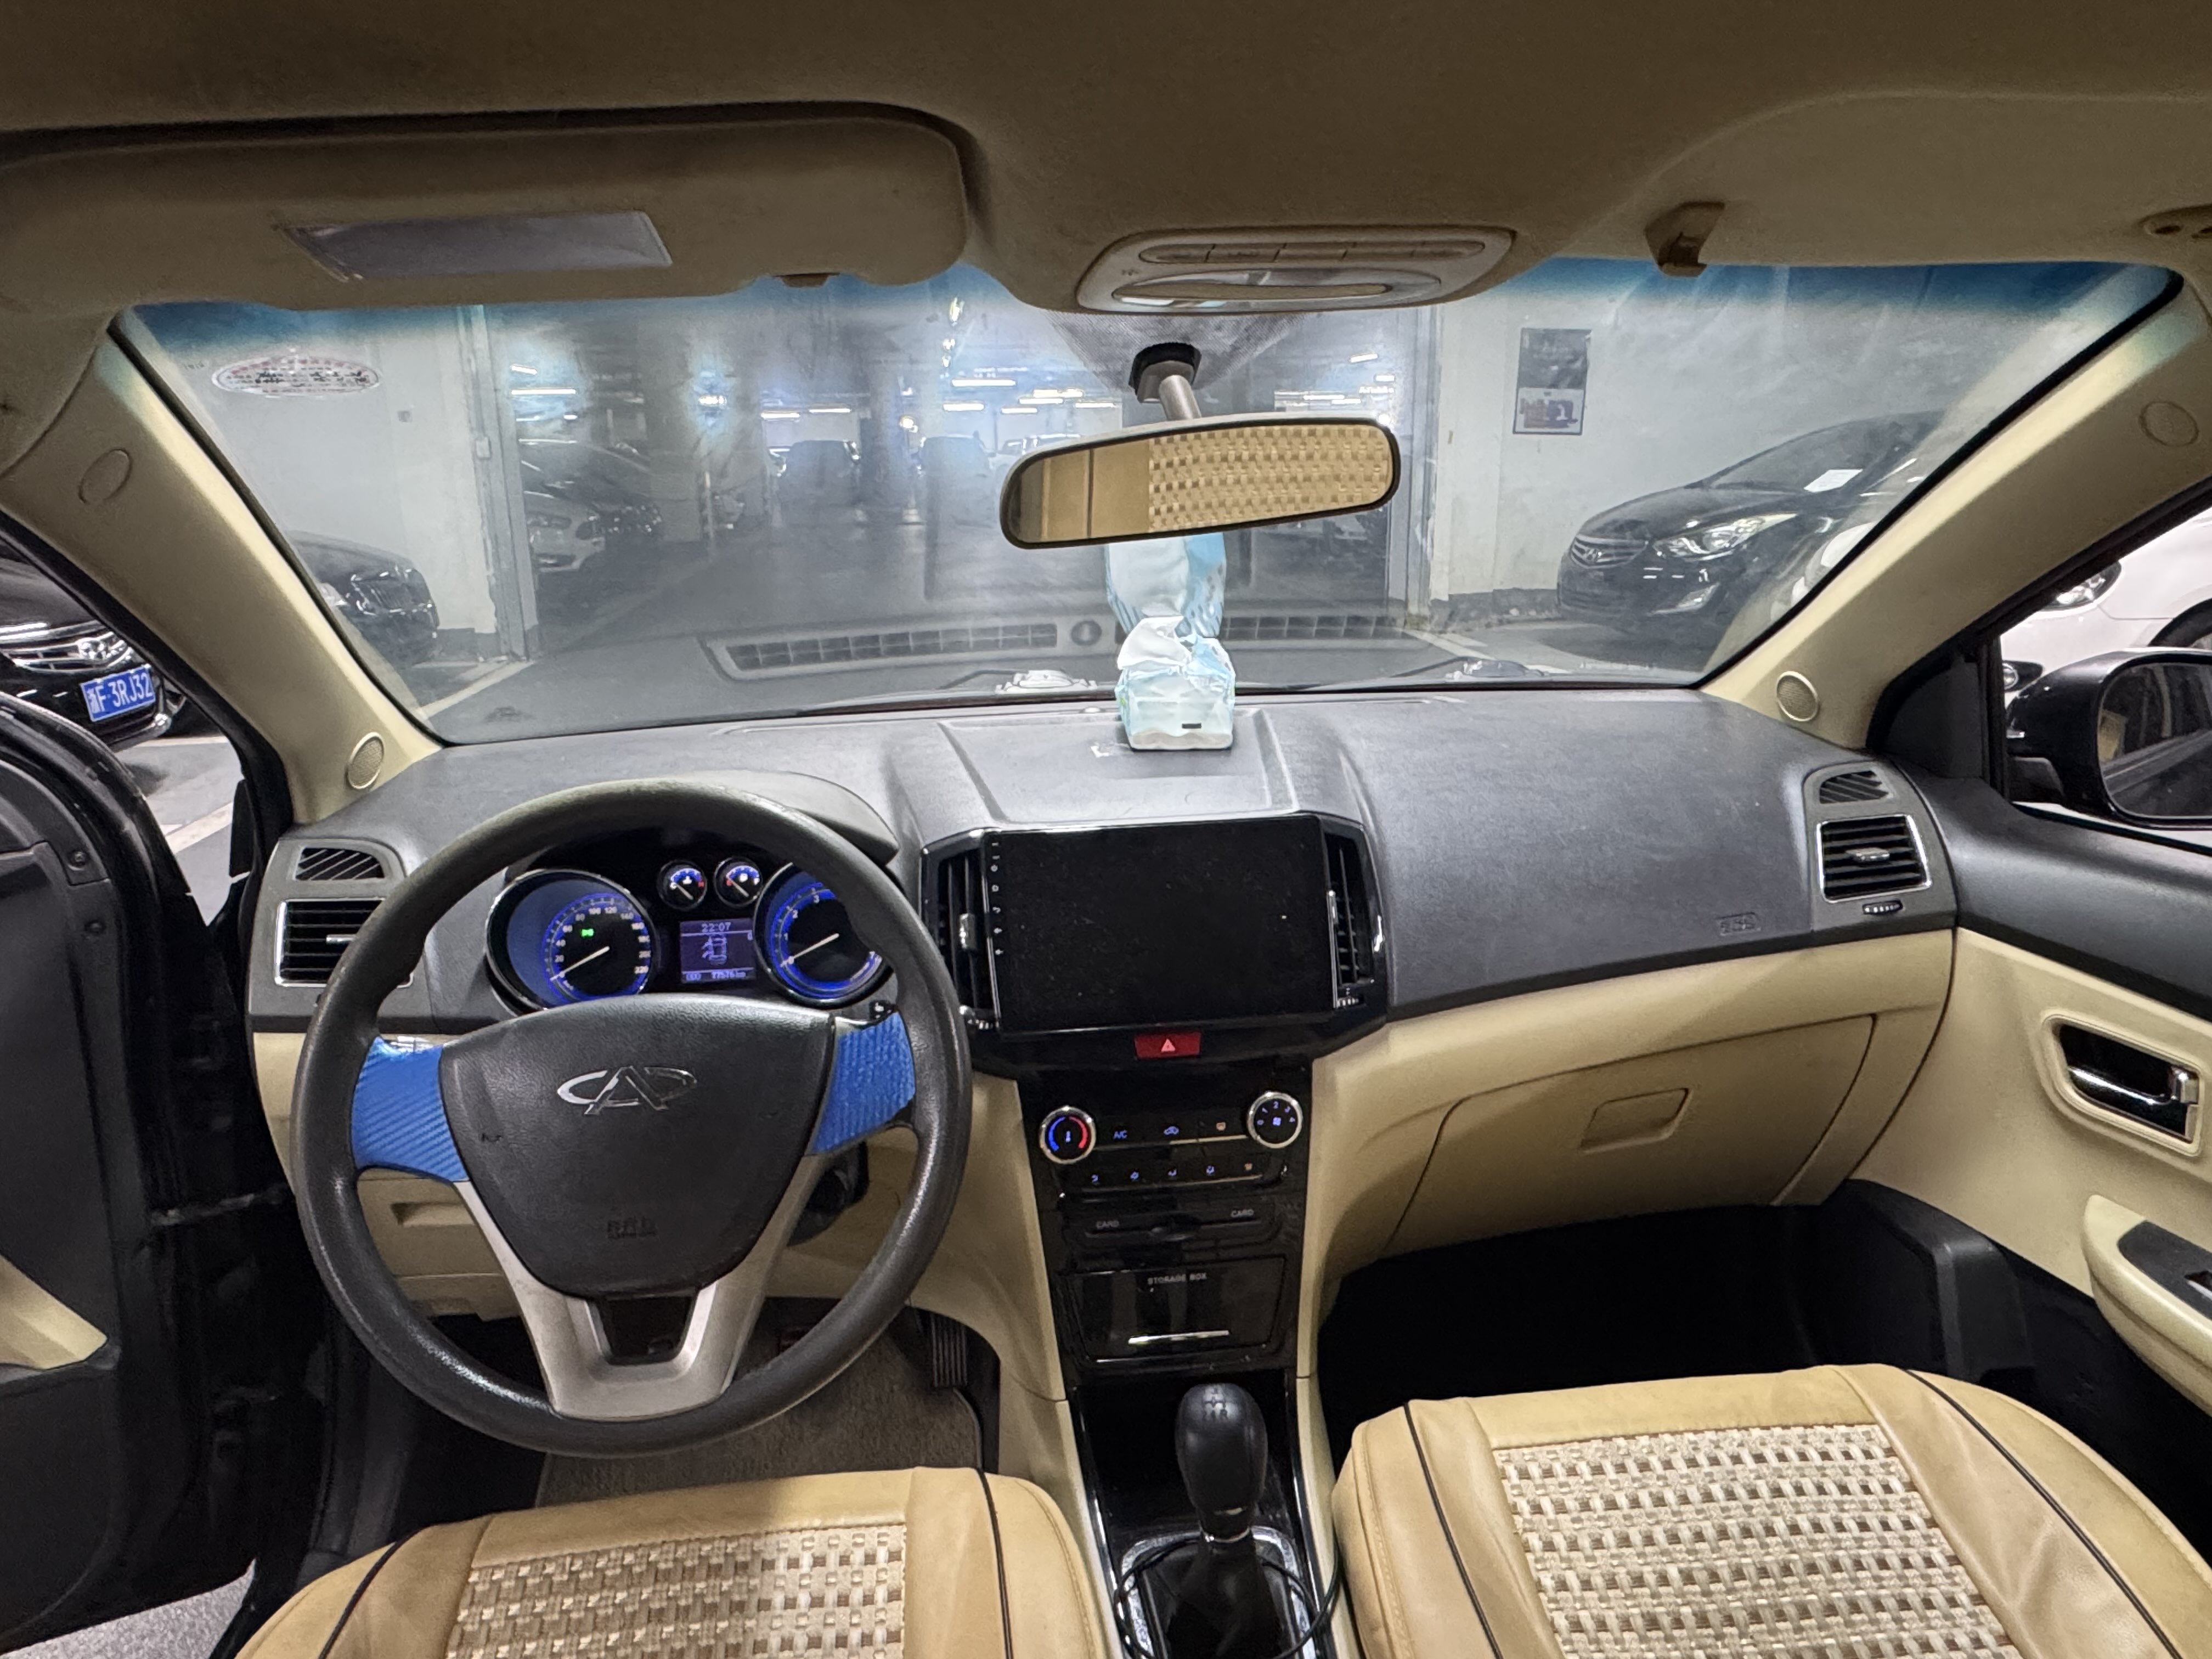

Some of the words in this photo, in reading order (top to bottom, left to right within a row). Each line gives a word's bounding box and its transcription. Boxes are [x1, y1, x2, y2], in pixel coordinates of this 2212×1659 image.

[813, 894, 820, 904] 3
[792, 910, 799, 919] 2
[563, 924, 573, 933] 60
[701, 922, 731, 933] 22:07
[555, 939, 566, 947] 40
[555, 955, 565, 963] 20
[1273, 1101, 1279, 1109] 2
[1113, 1130, 1128, 1140] A/C
[1231, 1209, 1254, 1218] CARD
[1096, 1220, 1120, 1229] CARD
[1148, 1273, 1186, 1285] STORAGE
[1189, 1273, 1207, 1281] BOX
